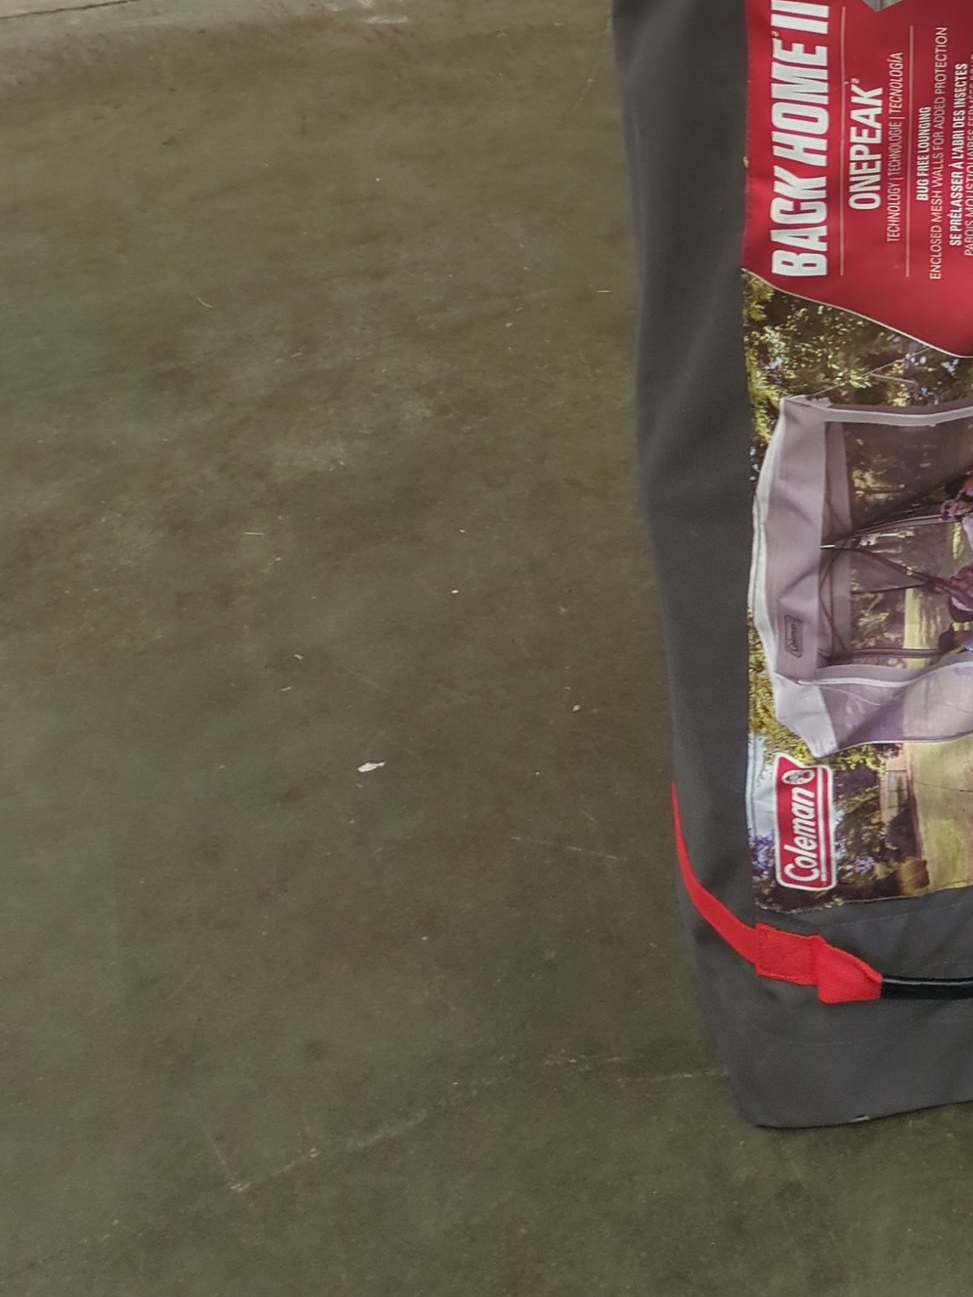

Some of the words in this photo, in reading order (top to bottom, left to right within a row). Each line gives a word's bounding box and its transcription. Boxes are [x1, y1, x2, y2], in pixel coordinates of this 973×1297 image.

[771, 0, 829, 34] II
[886, 52, 904, 114] TECNOLOGÍA
[935, 27, 948, 94] PROTECTION
[771, 38, 829, 167] HOME
[954, 63, 968, 108] INSECTES
[918, 107, 931, 152] LOUNGING
[934, 97, 946, 129] ADDED
[953, 110, 966, 128] DES
[849, 84, 883, 210] ONEPEAK
[888, 122, 902, 176] TECHNOLOGIE
[933, 131, 945, 150] FOR
[952, 130, 965, 159] L'ABRI
[917, 154, 930, 176] FREE
[932, 153, 944, 187] WALLS
[886, 182, 901, 242] TECHNOLOGY
[916, 179, 929, 201] BUG
[930, 190, 943, 222] MESH
[947, 171, 964, 232] PRÉLASSER
[770, 165, 828, 276] BACK
[949, 233, 962, 246] SE
[929, 225, 942, 280] ENCLOSED
[784, 787, 820, 881] Coleman
